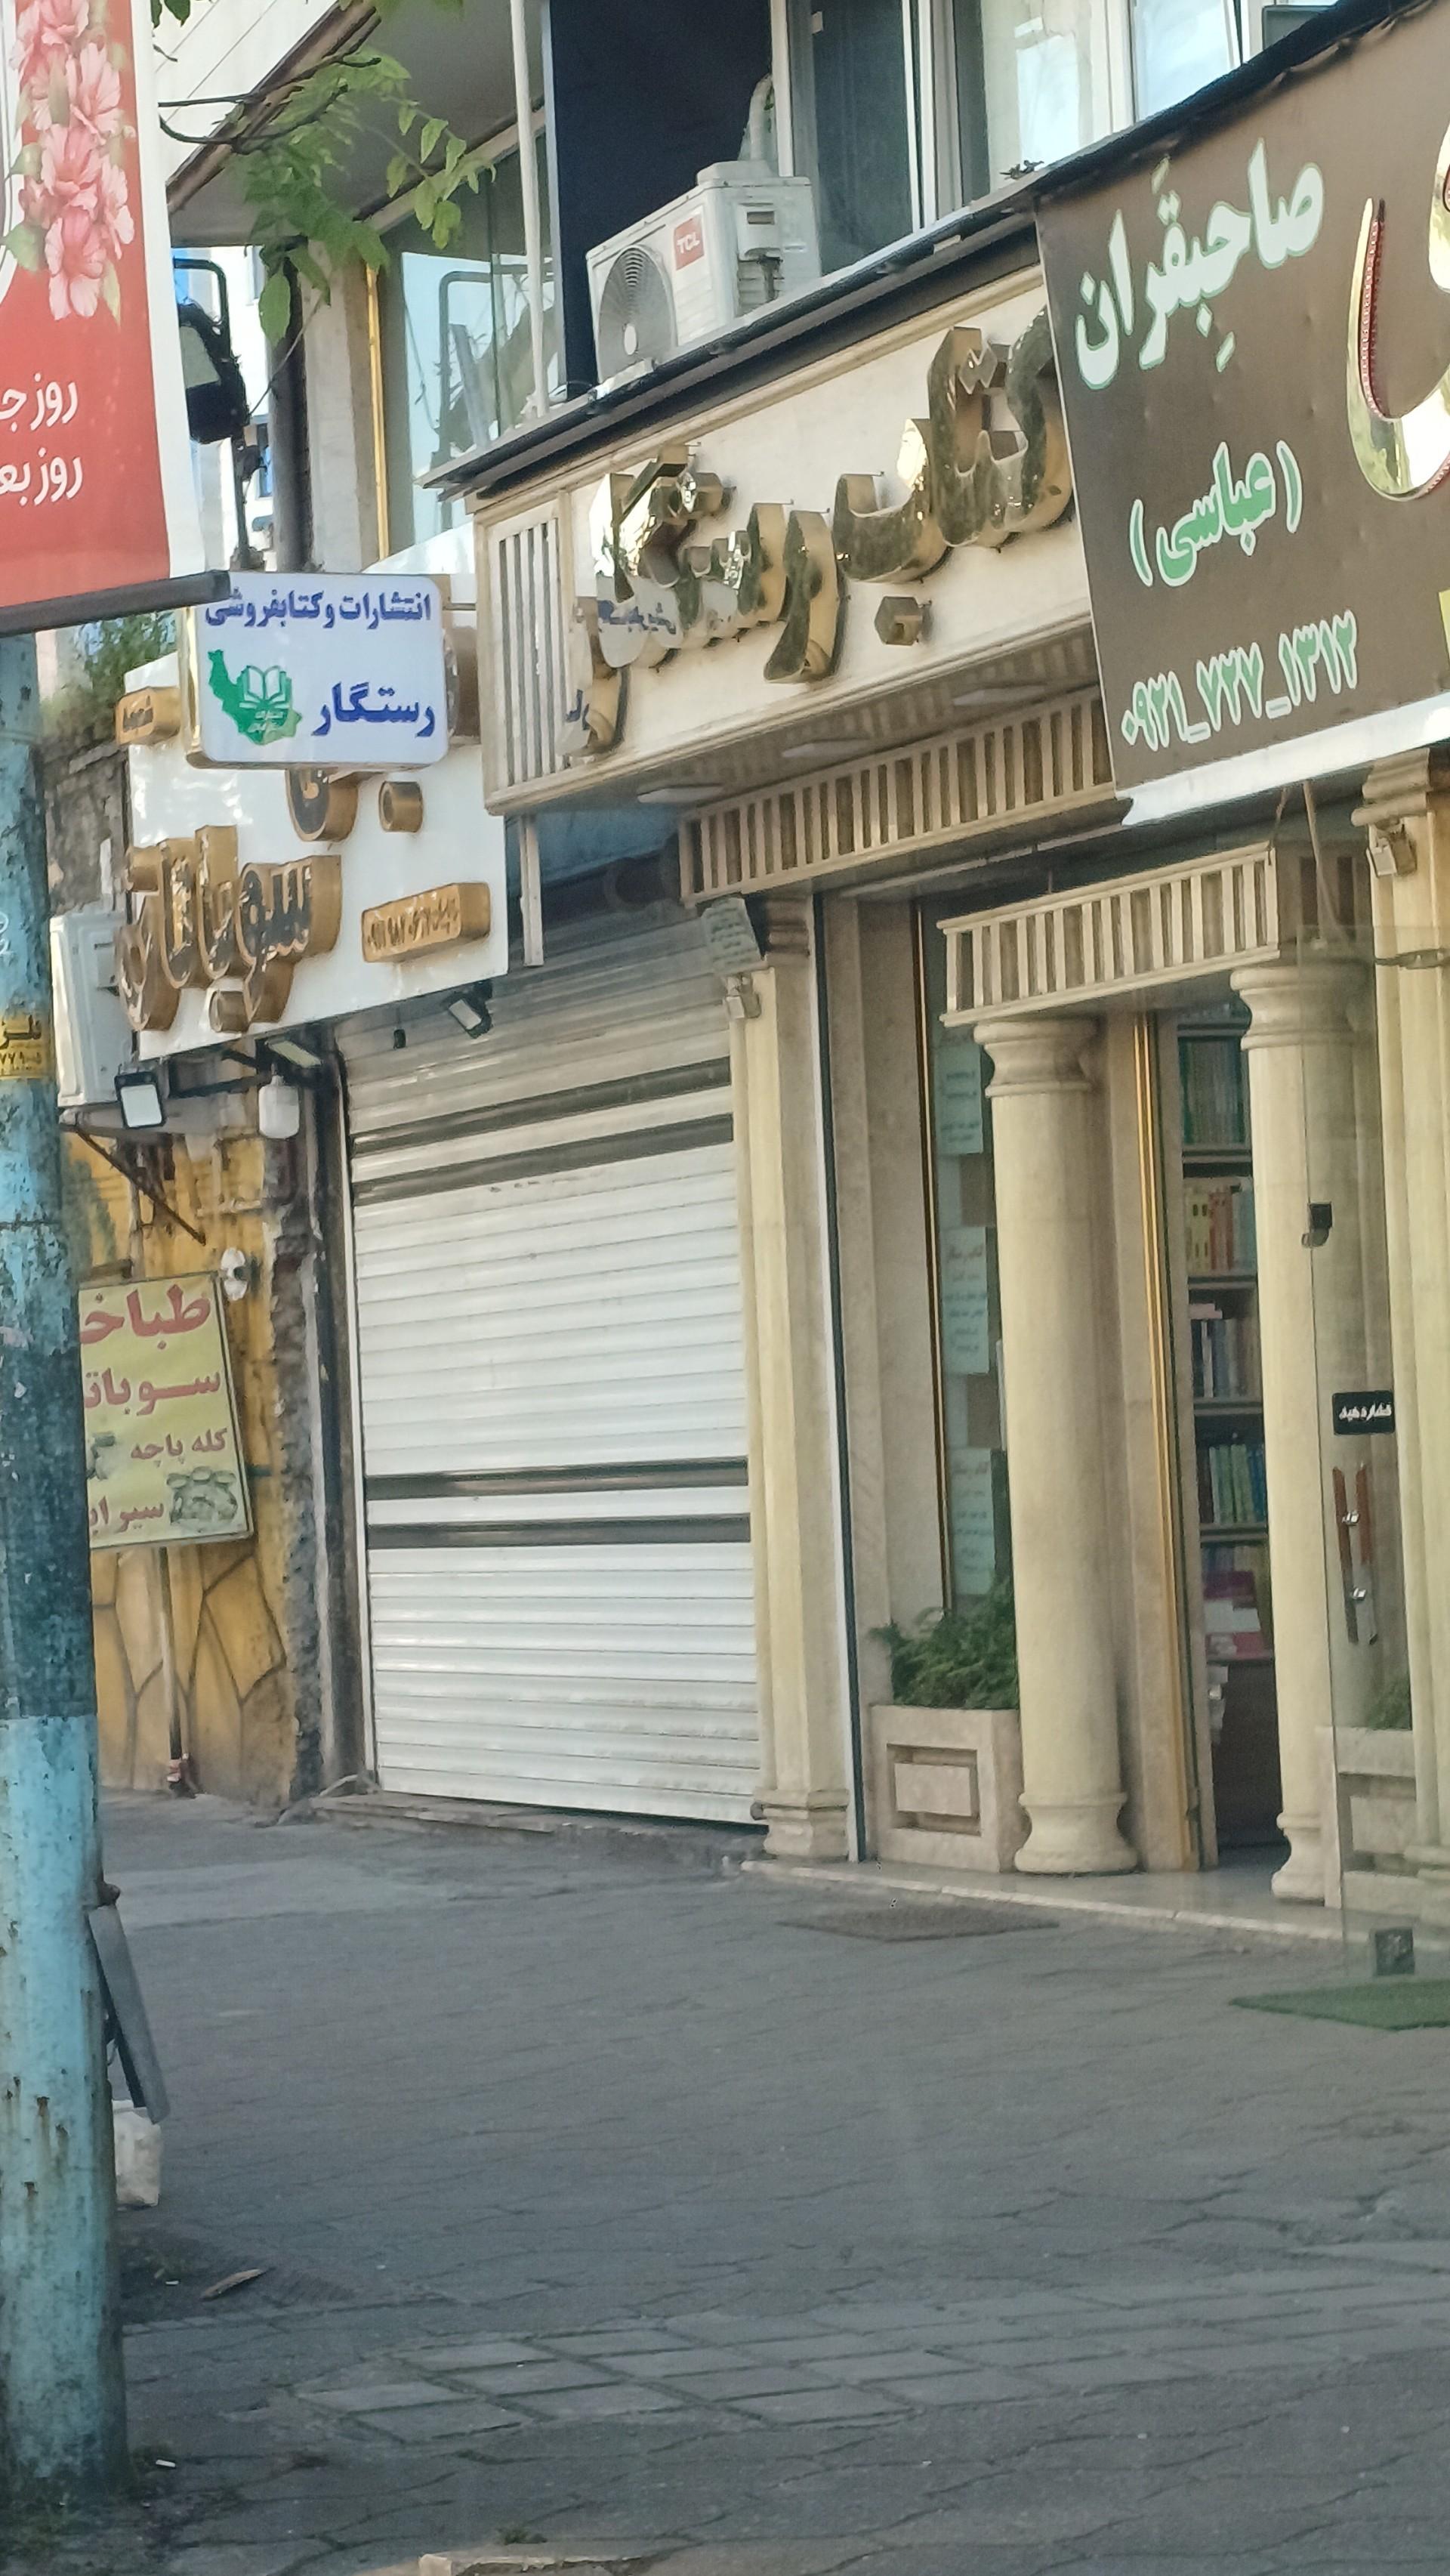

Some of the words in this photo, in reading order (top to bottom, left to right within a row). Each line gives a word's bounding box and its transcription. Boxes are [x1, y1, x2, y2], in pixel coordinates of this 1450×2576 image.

[677, 231, 701, 254] TCL
[30, 372, 79, 431] روز
[34, 447, 83, 505] روز
[1129, 440, 1303, 587] (عباسی)
[339, 591, 431, 630] انتشارات
[310, 681, 436, 739] رستگار
[79, 1283, 211, 1349] طباخ
[84, 1367, 221, 1416] سوبات
[131, 1433, 184, 1469] پاچه
[192, 1427, 227, 1453] کله
